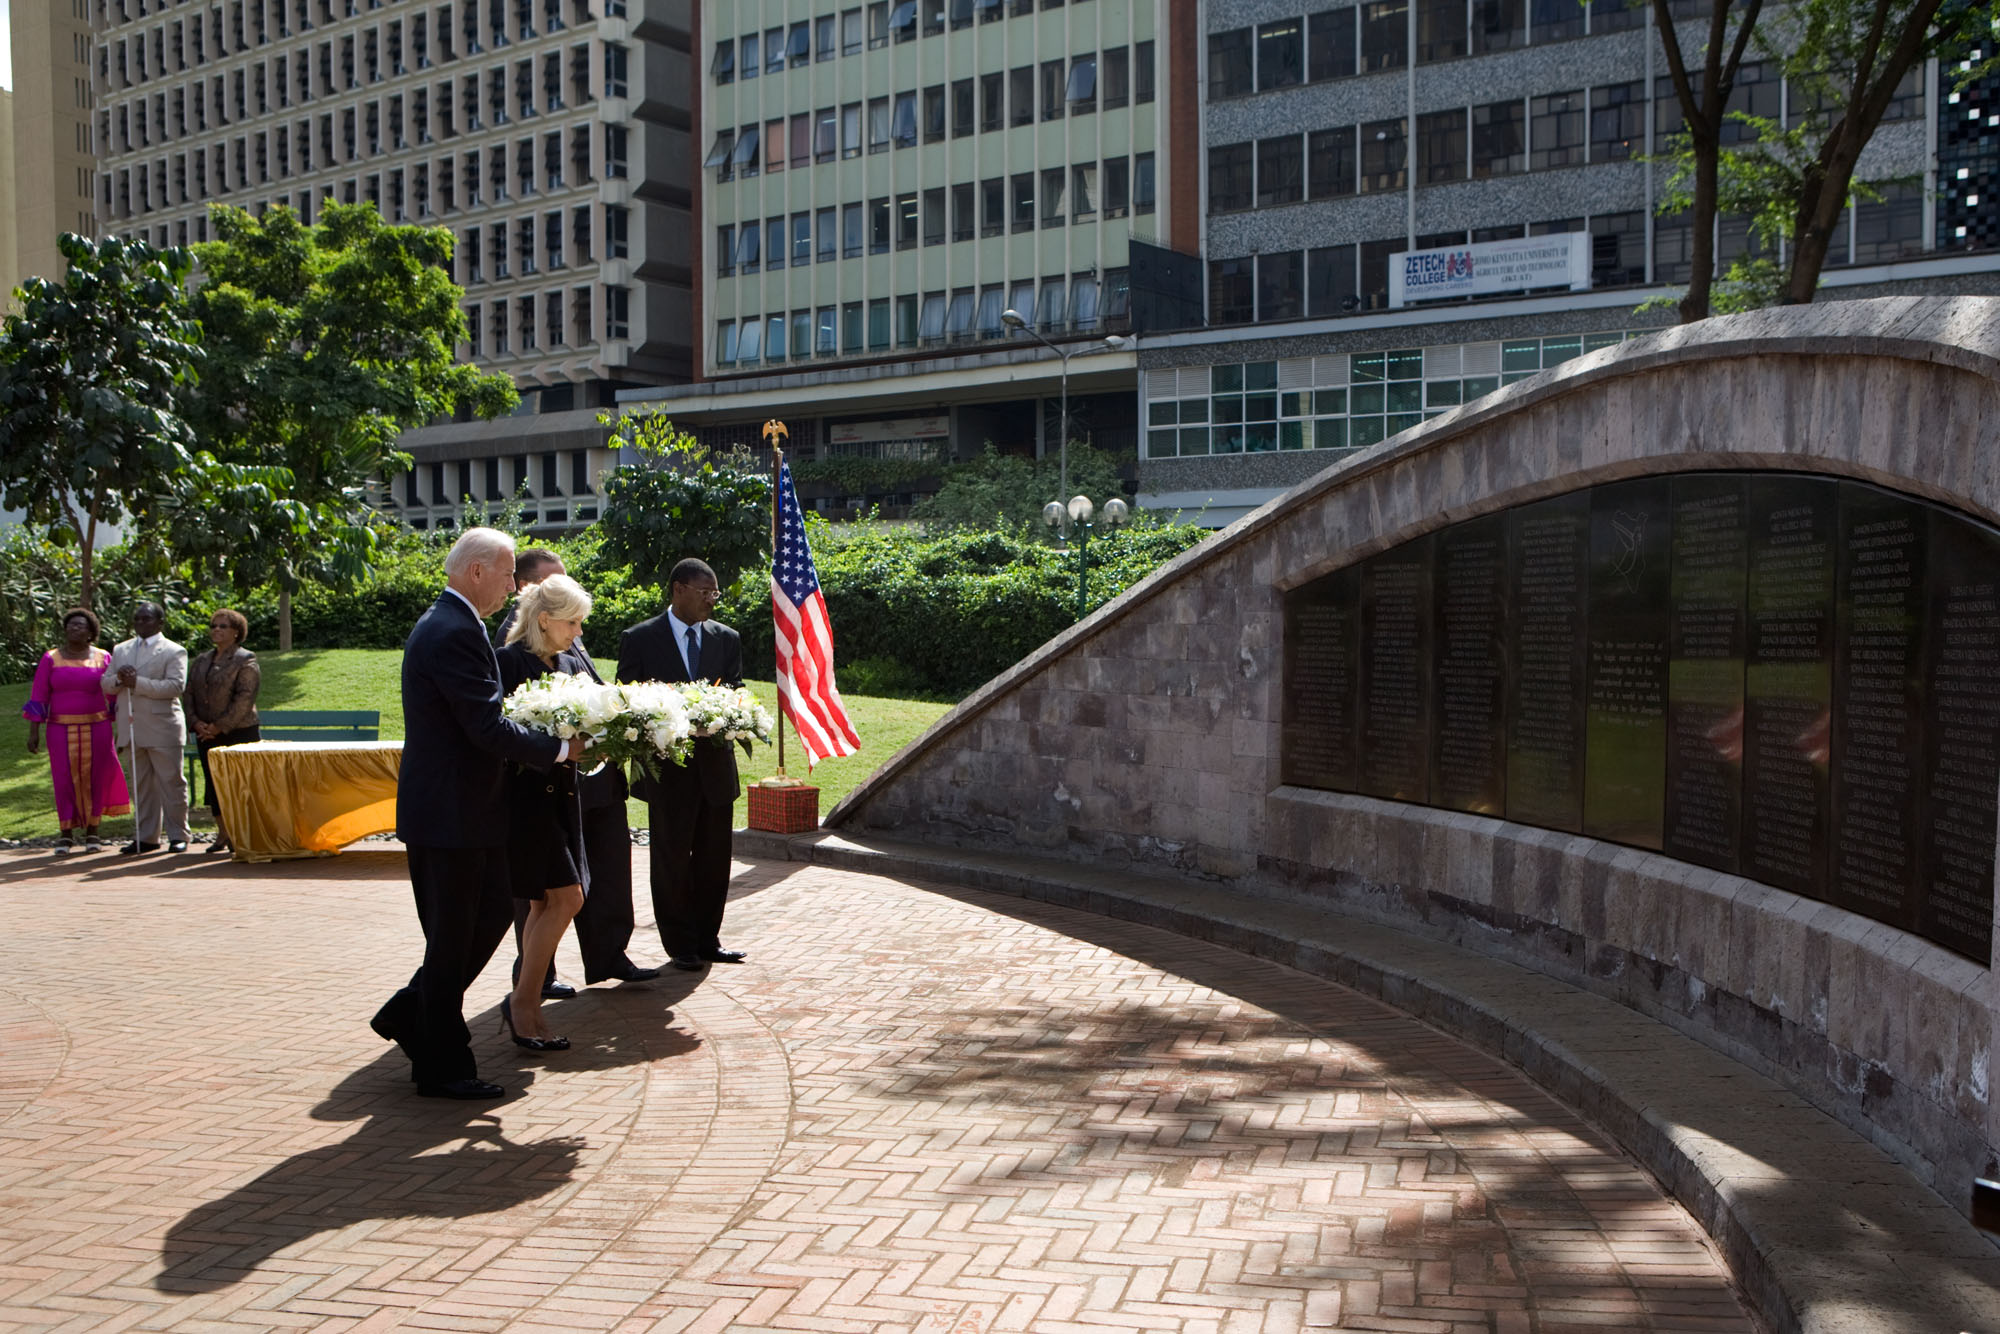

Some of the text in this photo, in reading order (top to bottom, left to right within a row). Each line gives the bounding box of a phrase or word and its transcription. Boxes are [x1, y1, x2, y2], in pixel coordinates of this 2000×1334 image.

[1406, 253, 1446, 274] ZETECH
[1492, 250, 1524, 264] KENYATTA
[1524, 247, 1559, 262] UNIVERSITY
[1560, 247, 1569, 257] OF
[1476, 260, 1567, 277] AGRICULTURE AND TECHNOLOGY
[1406, 272, 1446, 286] COLLEGE
[1405, 281, 1474, 295] DEVELOPING CAREERS
